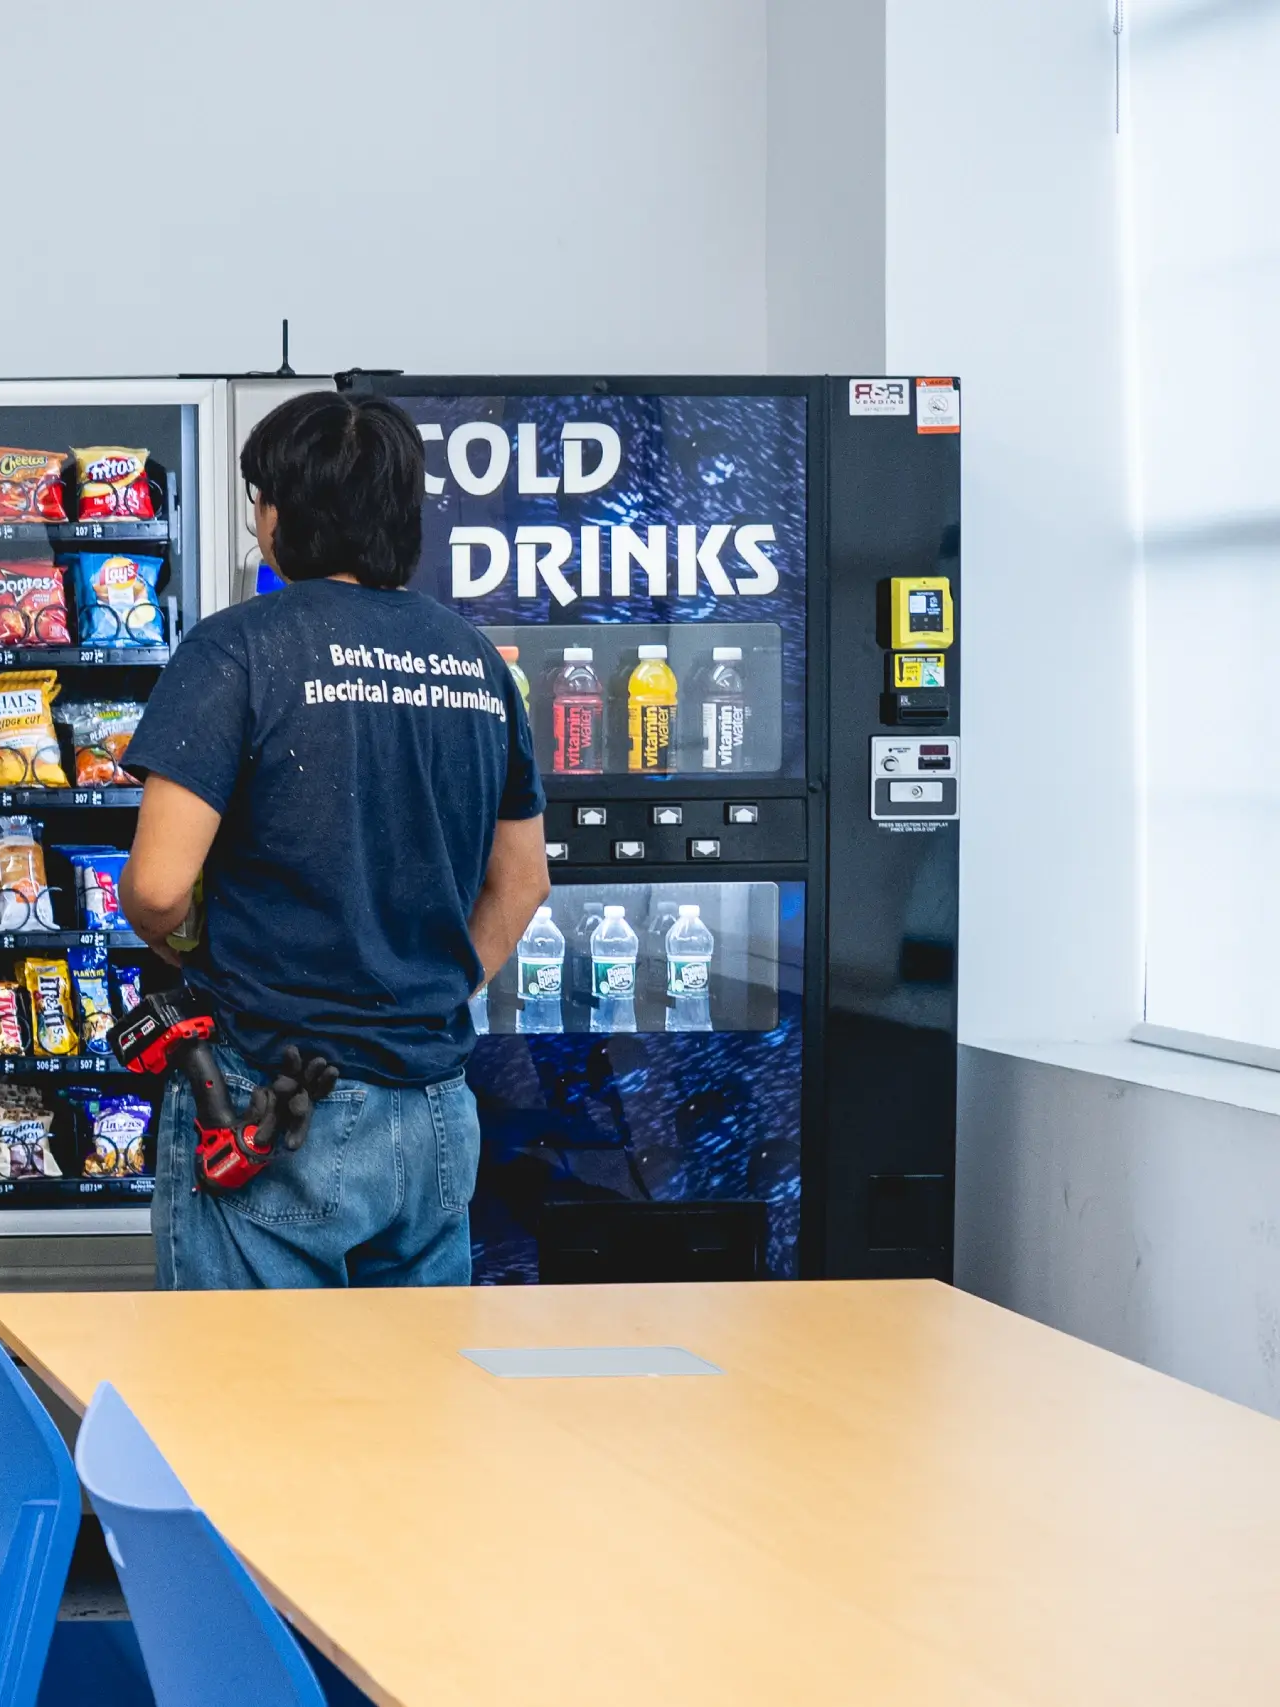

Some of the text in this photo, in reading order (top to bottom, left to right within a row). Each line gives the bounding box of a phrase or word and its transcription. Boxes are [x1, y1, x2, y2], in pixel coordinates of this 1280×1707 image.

[0, 454, 48, 477] Cheetos
[87, 457, 140, 483] Fritos
[75, 527, 88, 536] 107
[104, 564, 136, 584] Lay's
[448, 525, 780, 607] DRINKS
[80, 652, 94, 662] 207
[329, 644, 484, 680] Berk Trade School
[304, 678, 506, 723] Electrical and Plumbing
[25, 714, 41, 726] CUT
[581, 707, 592, 749] water
[658, 706, 669, 748] water
[733, 705, 744, 747] water
[567, 707, 581, 767] vitamin
[644, 706, 658, 767] vitamin
[718, 705, 732, 766] vitamin
[75, 793, 88, 803] 307
[80, 935, 94, 944] 407
[73, 968, 106, 977] PLANTERS
[36, 1061, 49, 1070] 506
[80, 1062, 93, 1072] 507
